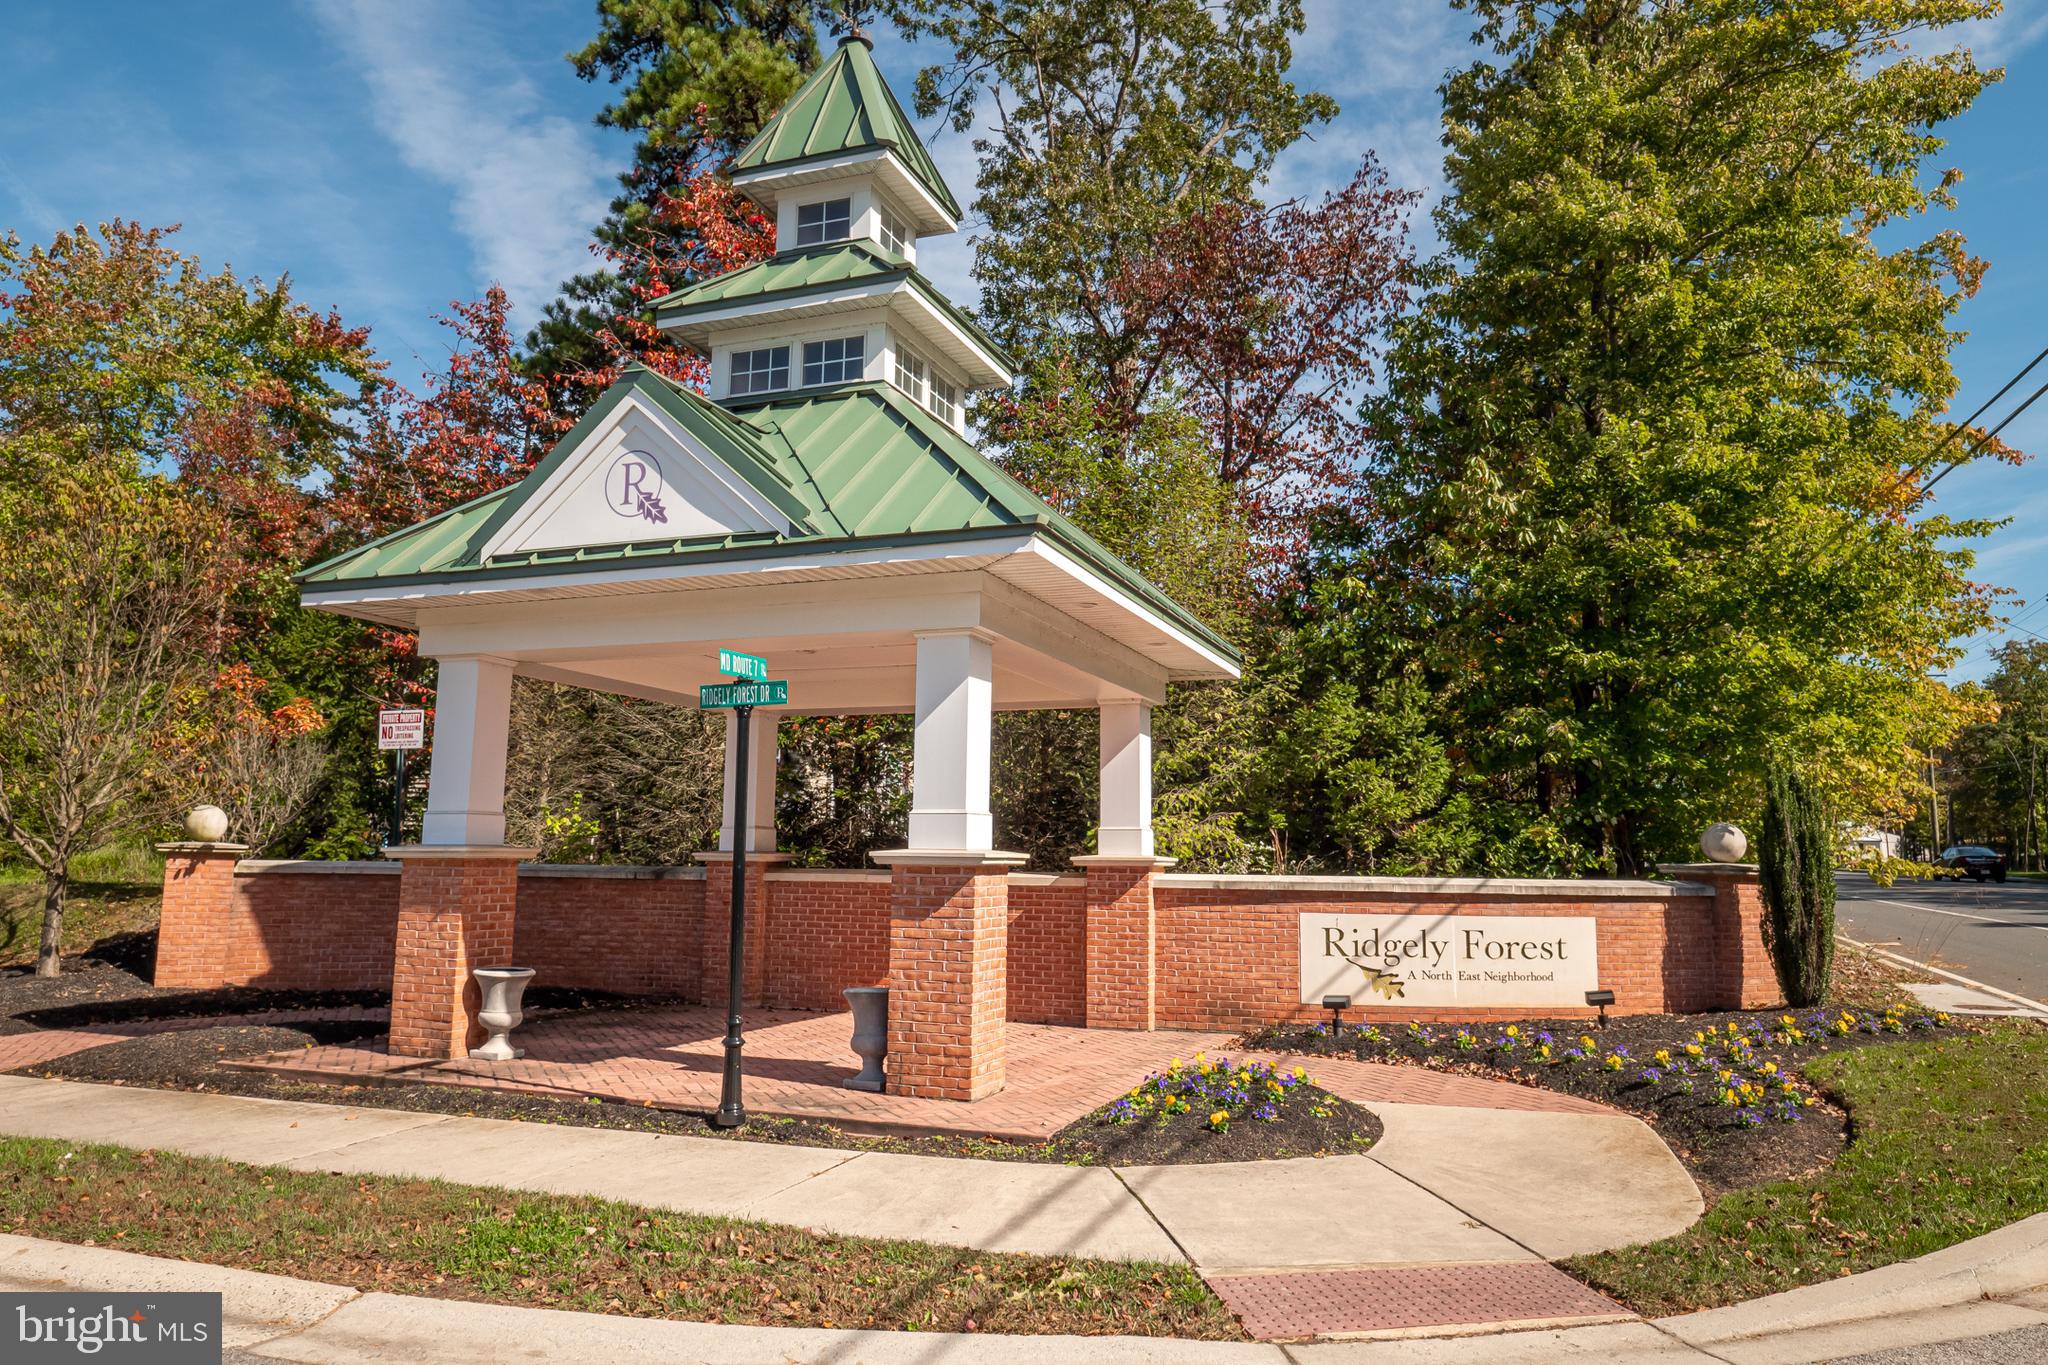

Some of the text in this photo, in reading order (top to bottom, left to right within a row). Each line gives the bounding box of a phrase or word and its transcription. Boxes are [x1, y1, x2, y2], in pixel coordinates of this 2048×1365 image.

[720, 652, 759, 677] MD ROUTE 7
[701, 684, 770, 706] RIDGELY FOREST DR
[382, 726, 393, 739] NO
[1322, 926, 1568, 967] Ridgely Forest
[1407, 970, 1554, 983] A North East Neighborhood
